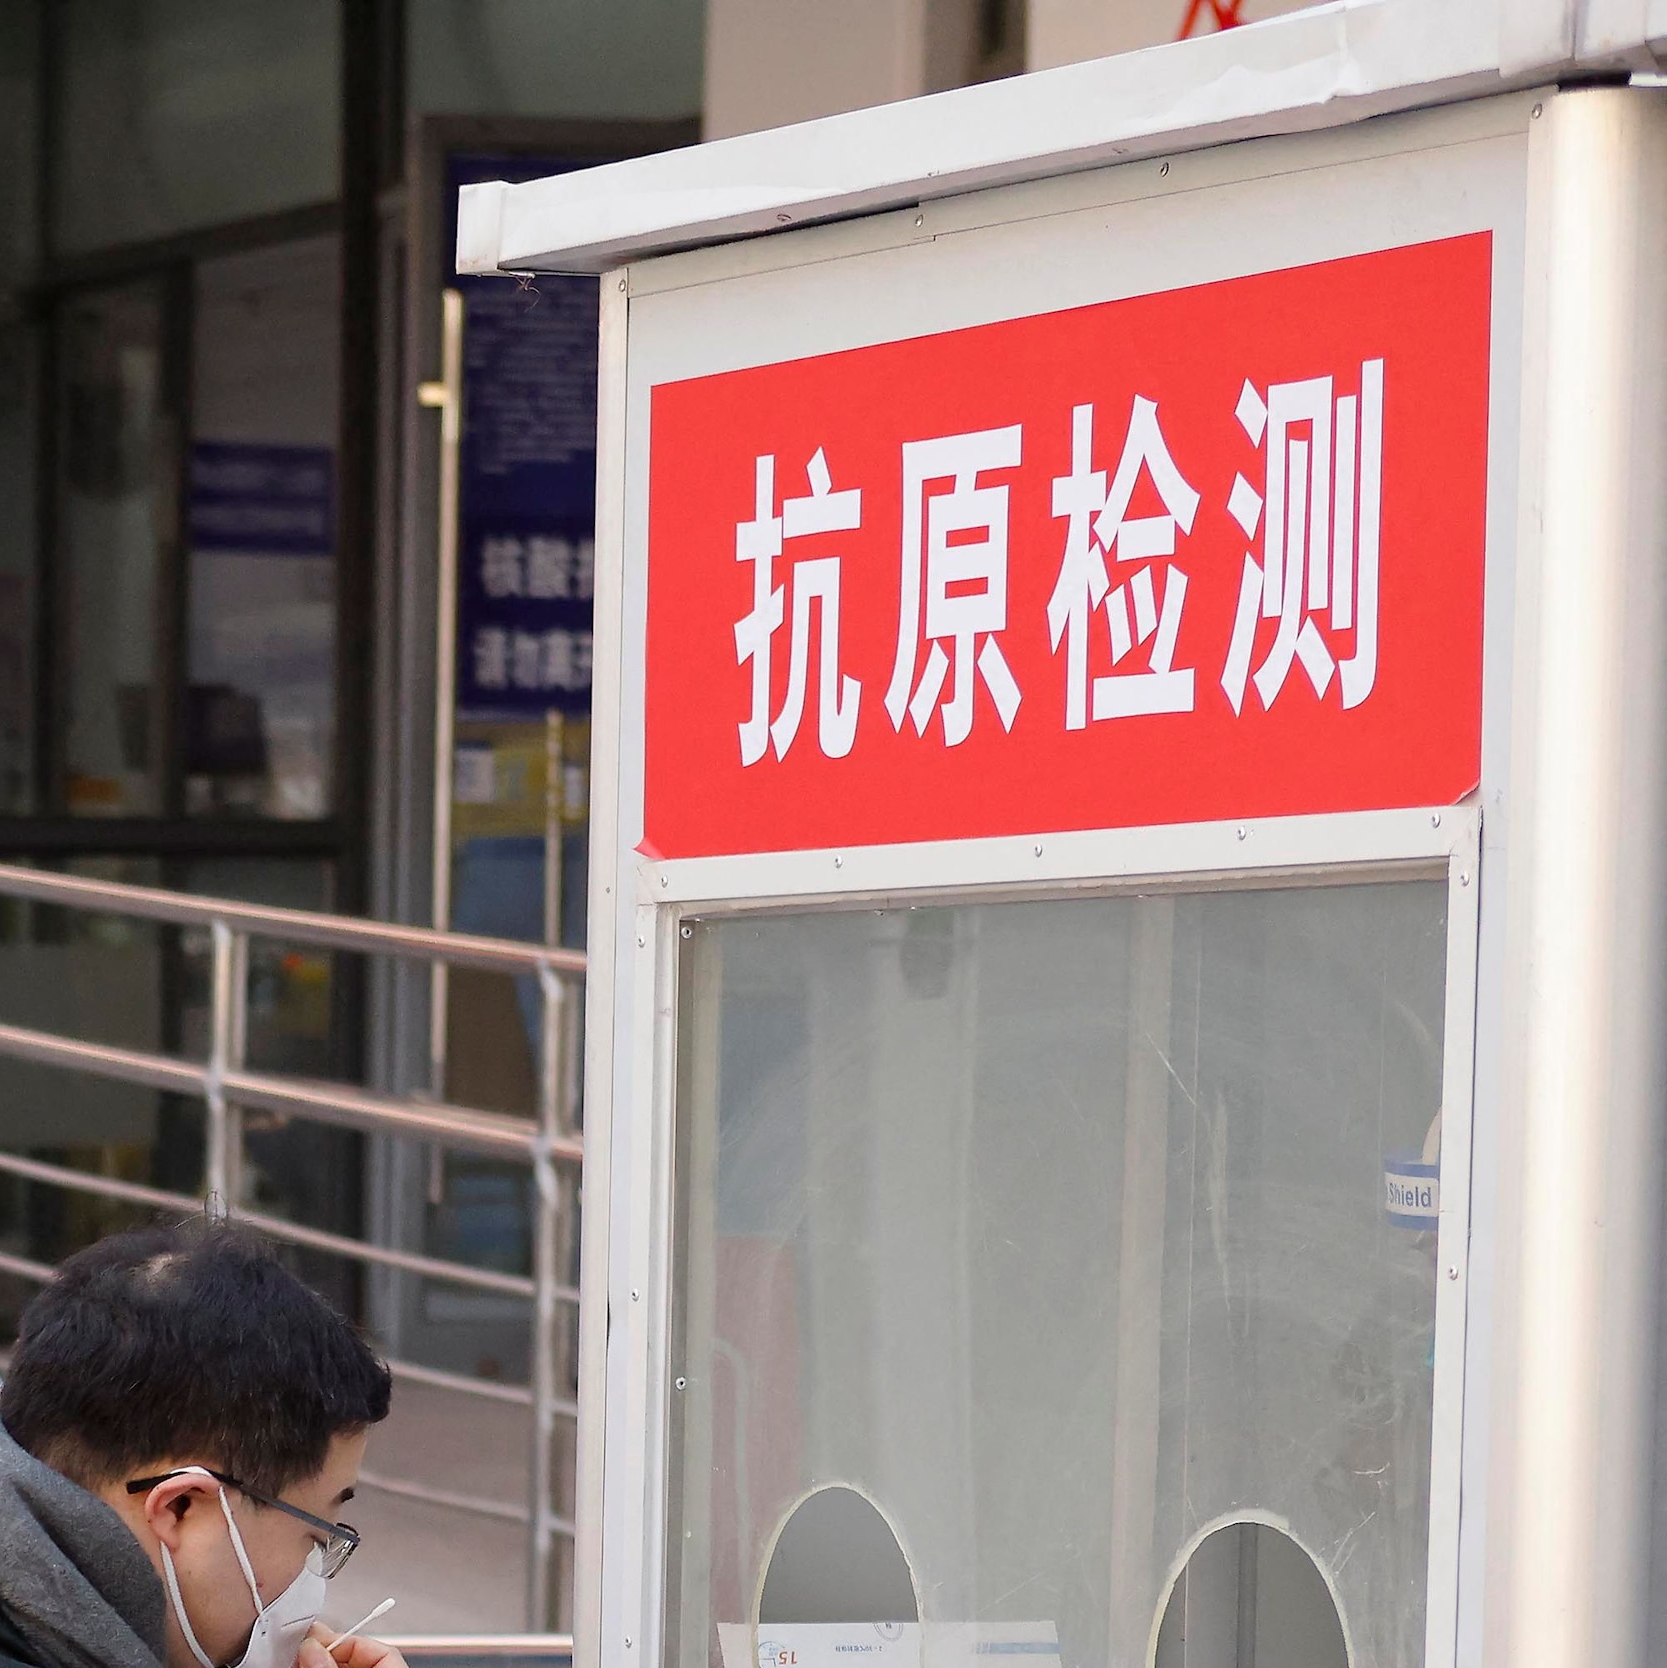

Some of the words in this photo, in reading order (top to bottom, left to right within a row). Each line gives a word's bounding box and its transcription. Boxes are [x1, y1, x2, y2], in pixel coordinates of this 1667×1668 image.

[732, 357, 1385, 768] 抗原检测
[1388, 1182, 1432, 1207] Shield
[779, 1650, 798, 1665] 15
